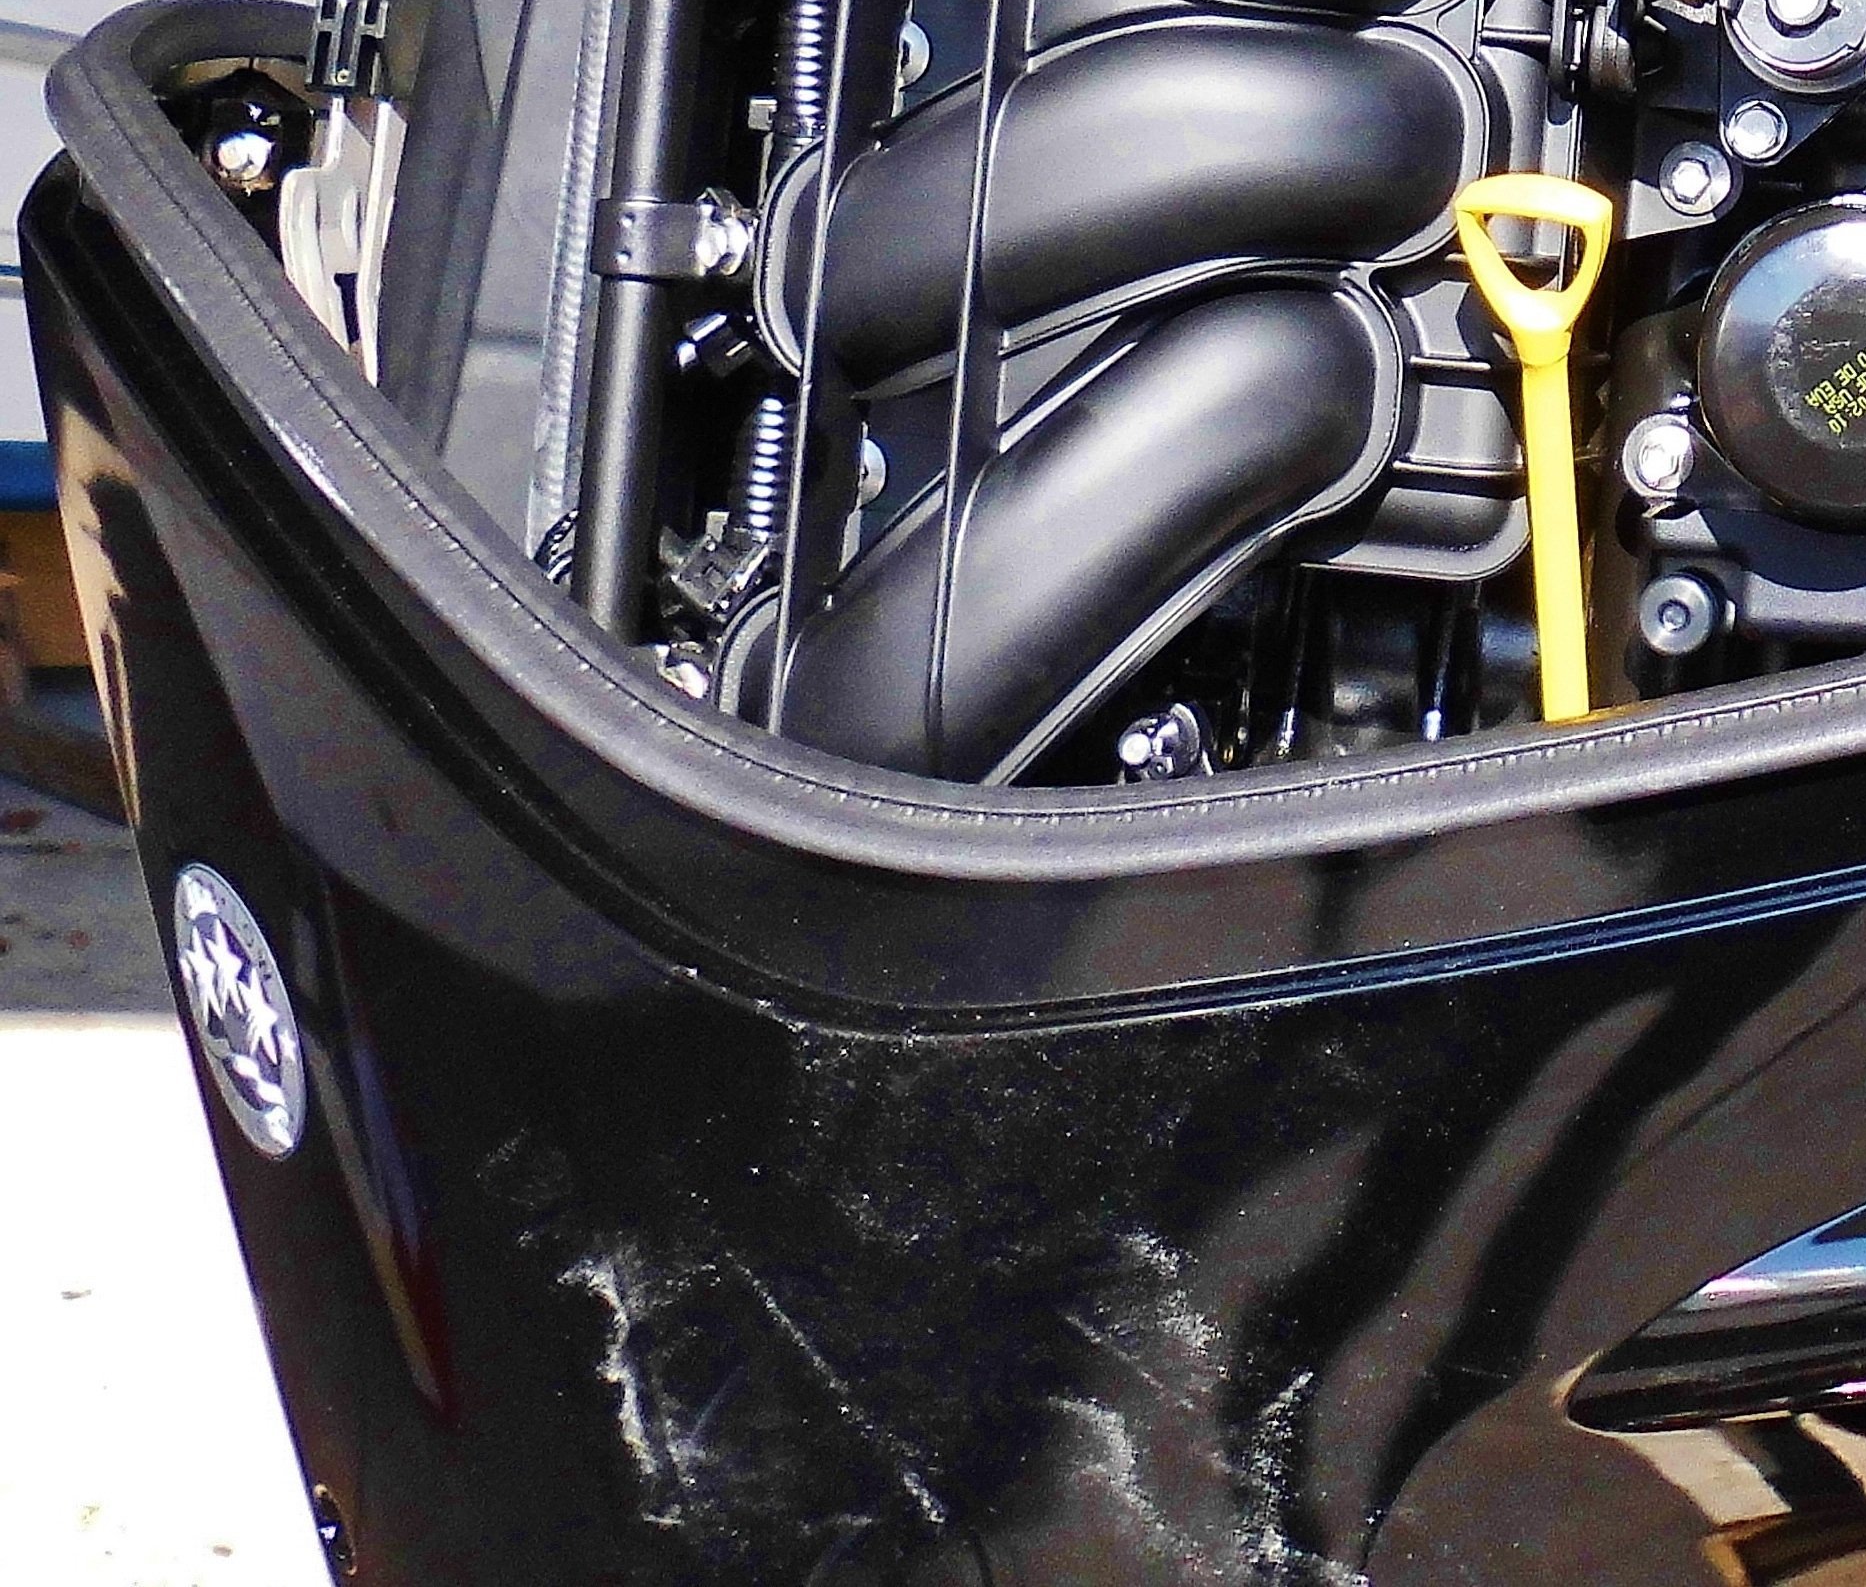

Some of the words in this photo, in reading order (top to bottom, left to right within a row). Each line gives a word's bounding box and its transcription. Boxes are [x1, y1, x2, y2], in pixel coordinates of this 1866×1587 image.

[1833, 363, 1857, 387] DE
[1804, 379, 1837, 408] EUA
[1822, 390, 1854, 415] USA
